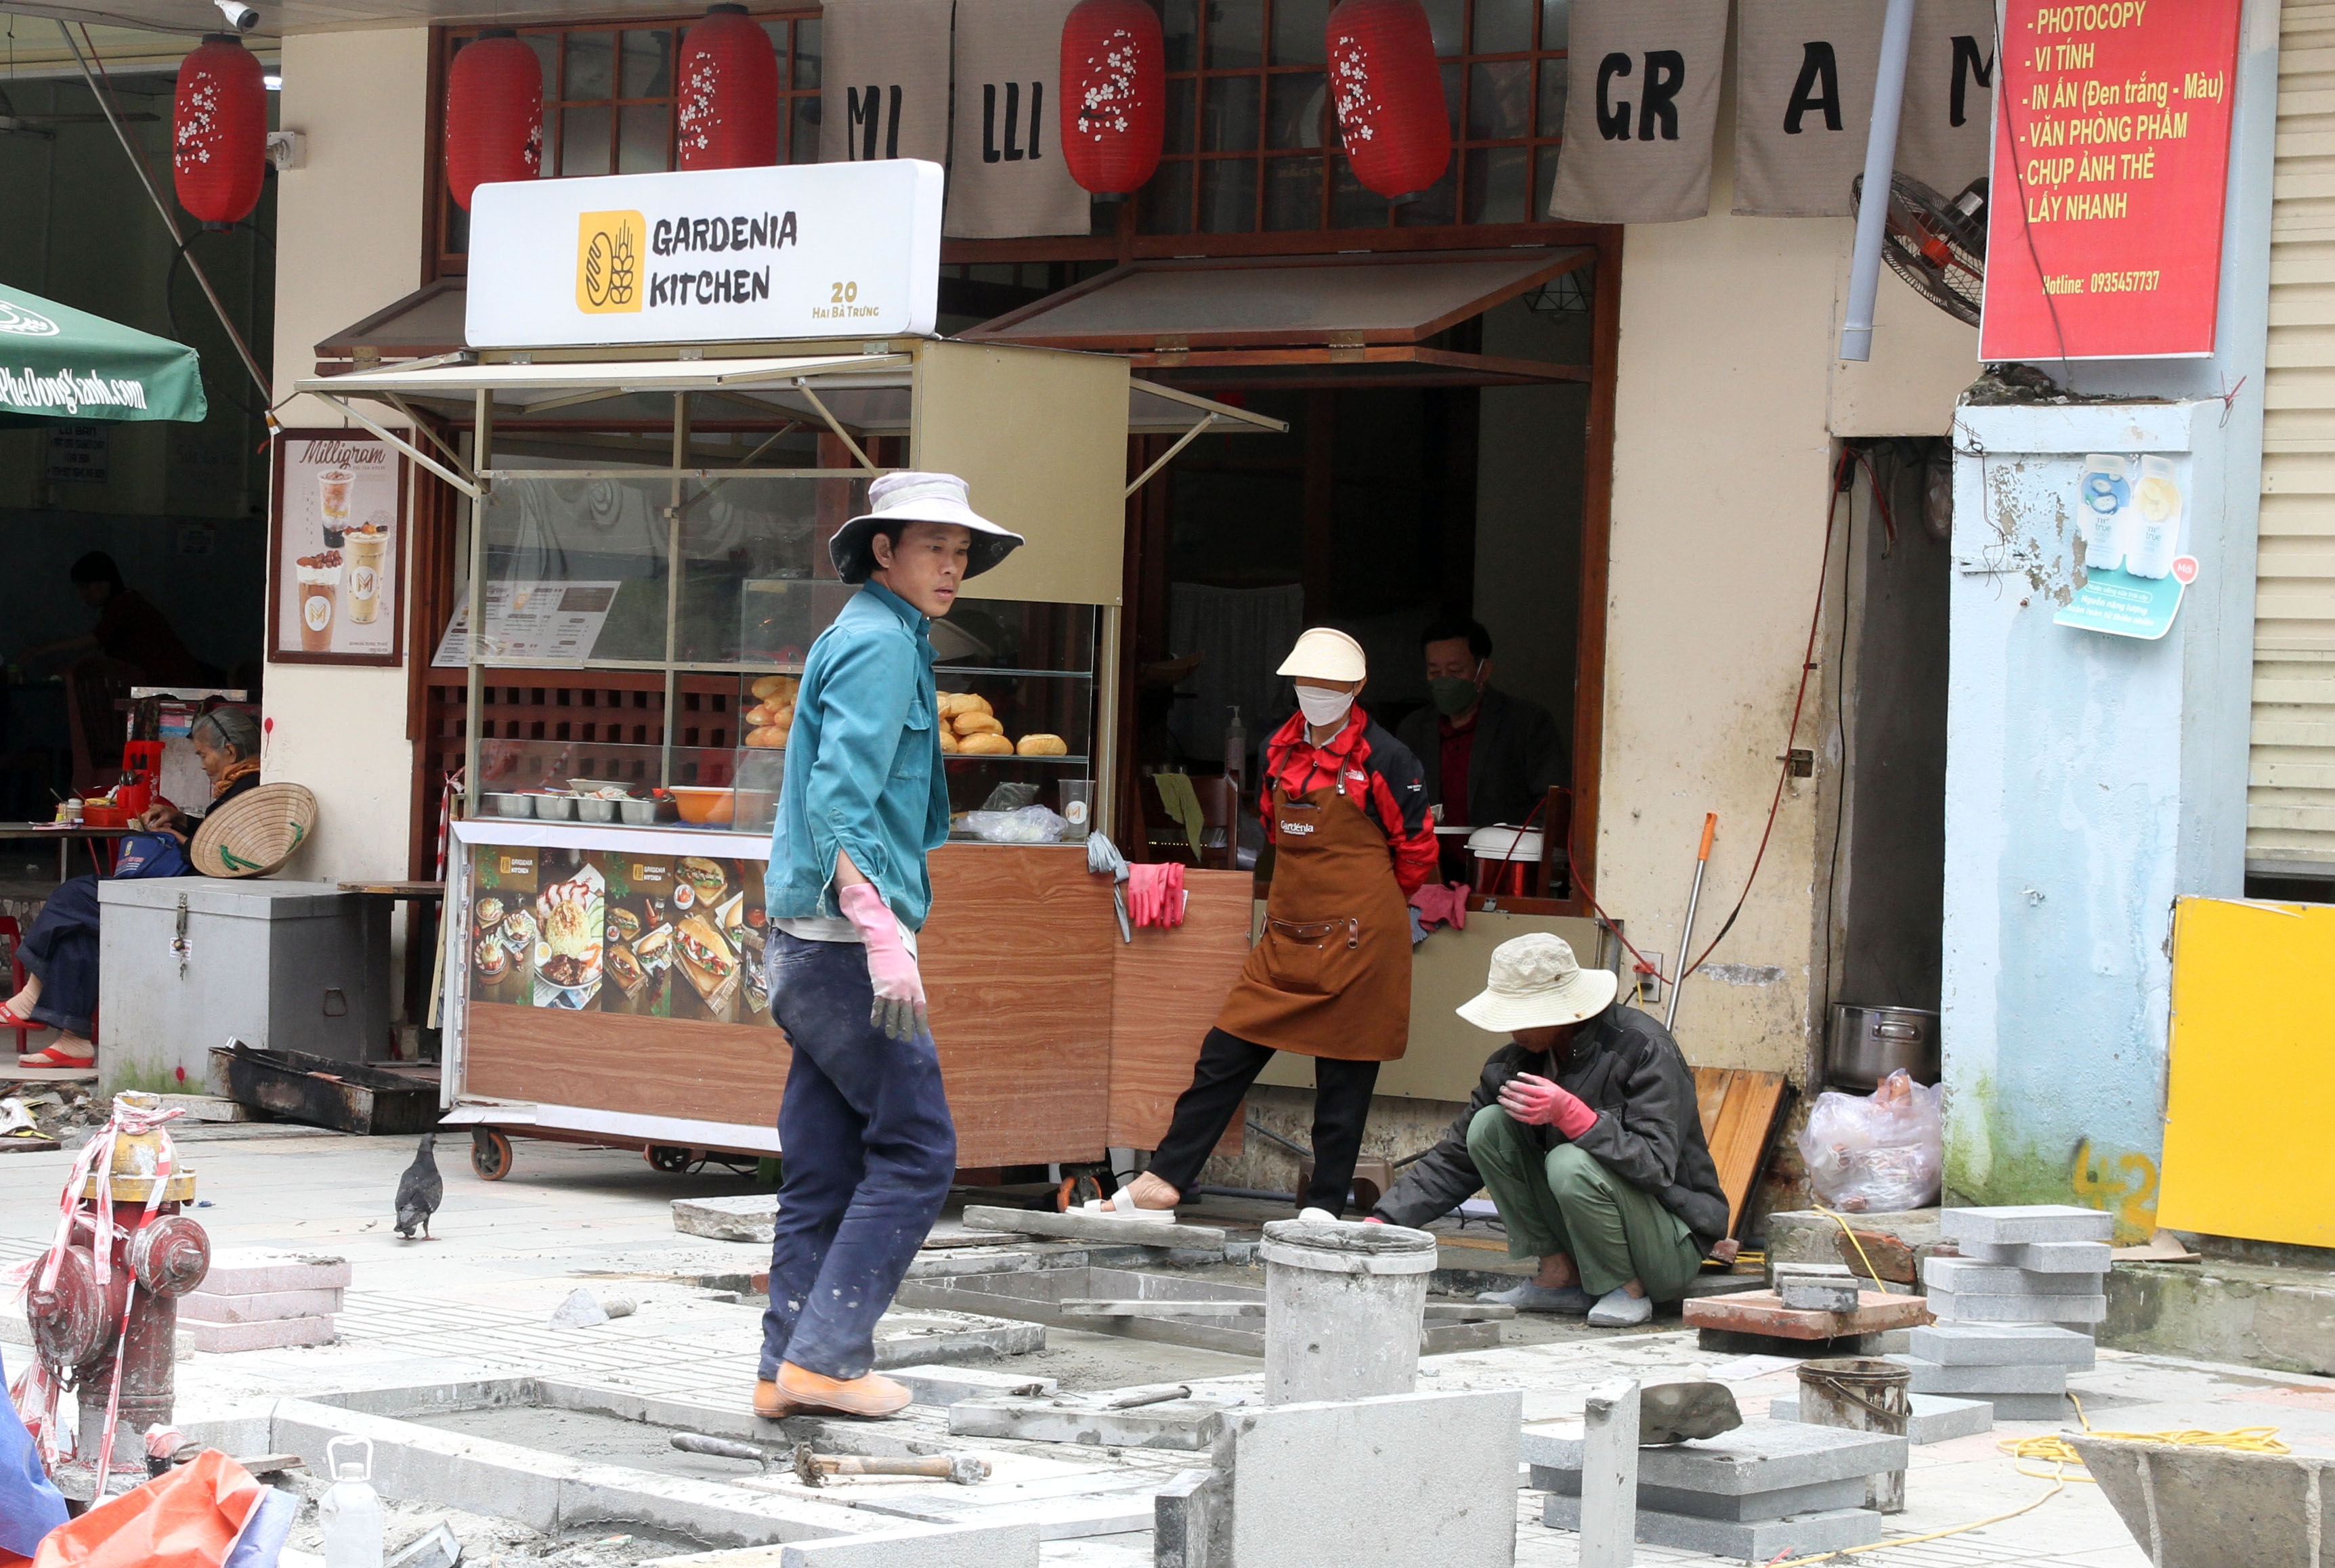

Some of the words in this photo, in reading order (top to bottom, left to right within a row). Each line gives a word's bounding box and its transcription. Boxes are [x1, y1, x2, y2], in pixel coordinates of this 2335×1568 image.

[2037, 1, 2146, 34] PHOTOCOPY
[2035, 46, 2051, 72] VI
[2055, 37, 2095, 70] TÍNH
[1595, 49, 1685, 140] GR
[1782, 41, 1843, 134] A
[2032, 84, 2049, 110] IN
[2053, 77, 2078, 108] ẤN
[2082, 80, 2120, 113] (Đen
[2124, 70, 2168, 108] trắng
[2183, 70, 2224, 104] Màu)
[2030, 114, 2064, 147] VĂN
[2069, 111, 2131, 145] PHÒNG
[2137, 106, 2188, 141] PHẨM
[2027, 157, 2075, 190] CHỤP
[2078, 150, 2116, 183] ẢNH
[2120, 146, 2155, 179] THẺ
[2028, 190, 2063, 223] LẤY
[2065, 192, 2128, 221] NHANH
[652, 211, 797, 256] GARDENIA
[649, 265, 770, 307] KITCHEN
[831, 281, 857, 303] 20
[2042, 274, 2084, 295] Hotline:
[2091, 270, 2160, 292] 0935457737
[0, 367, 148, 414] PheDongXanh.com
[299, 440, 386, 470] Milligram
